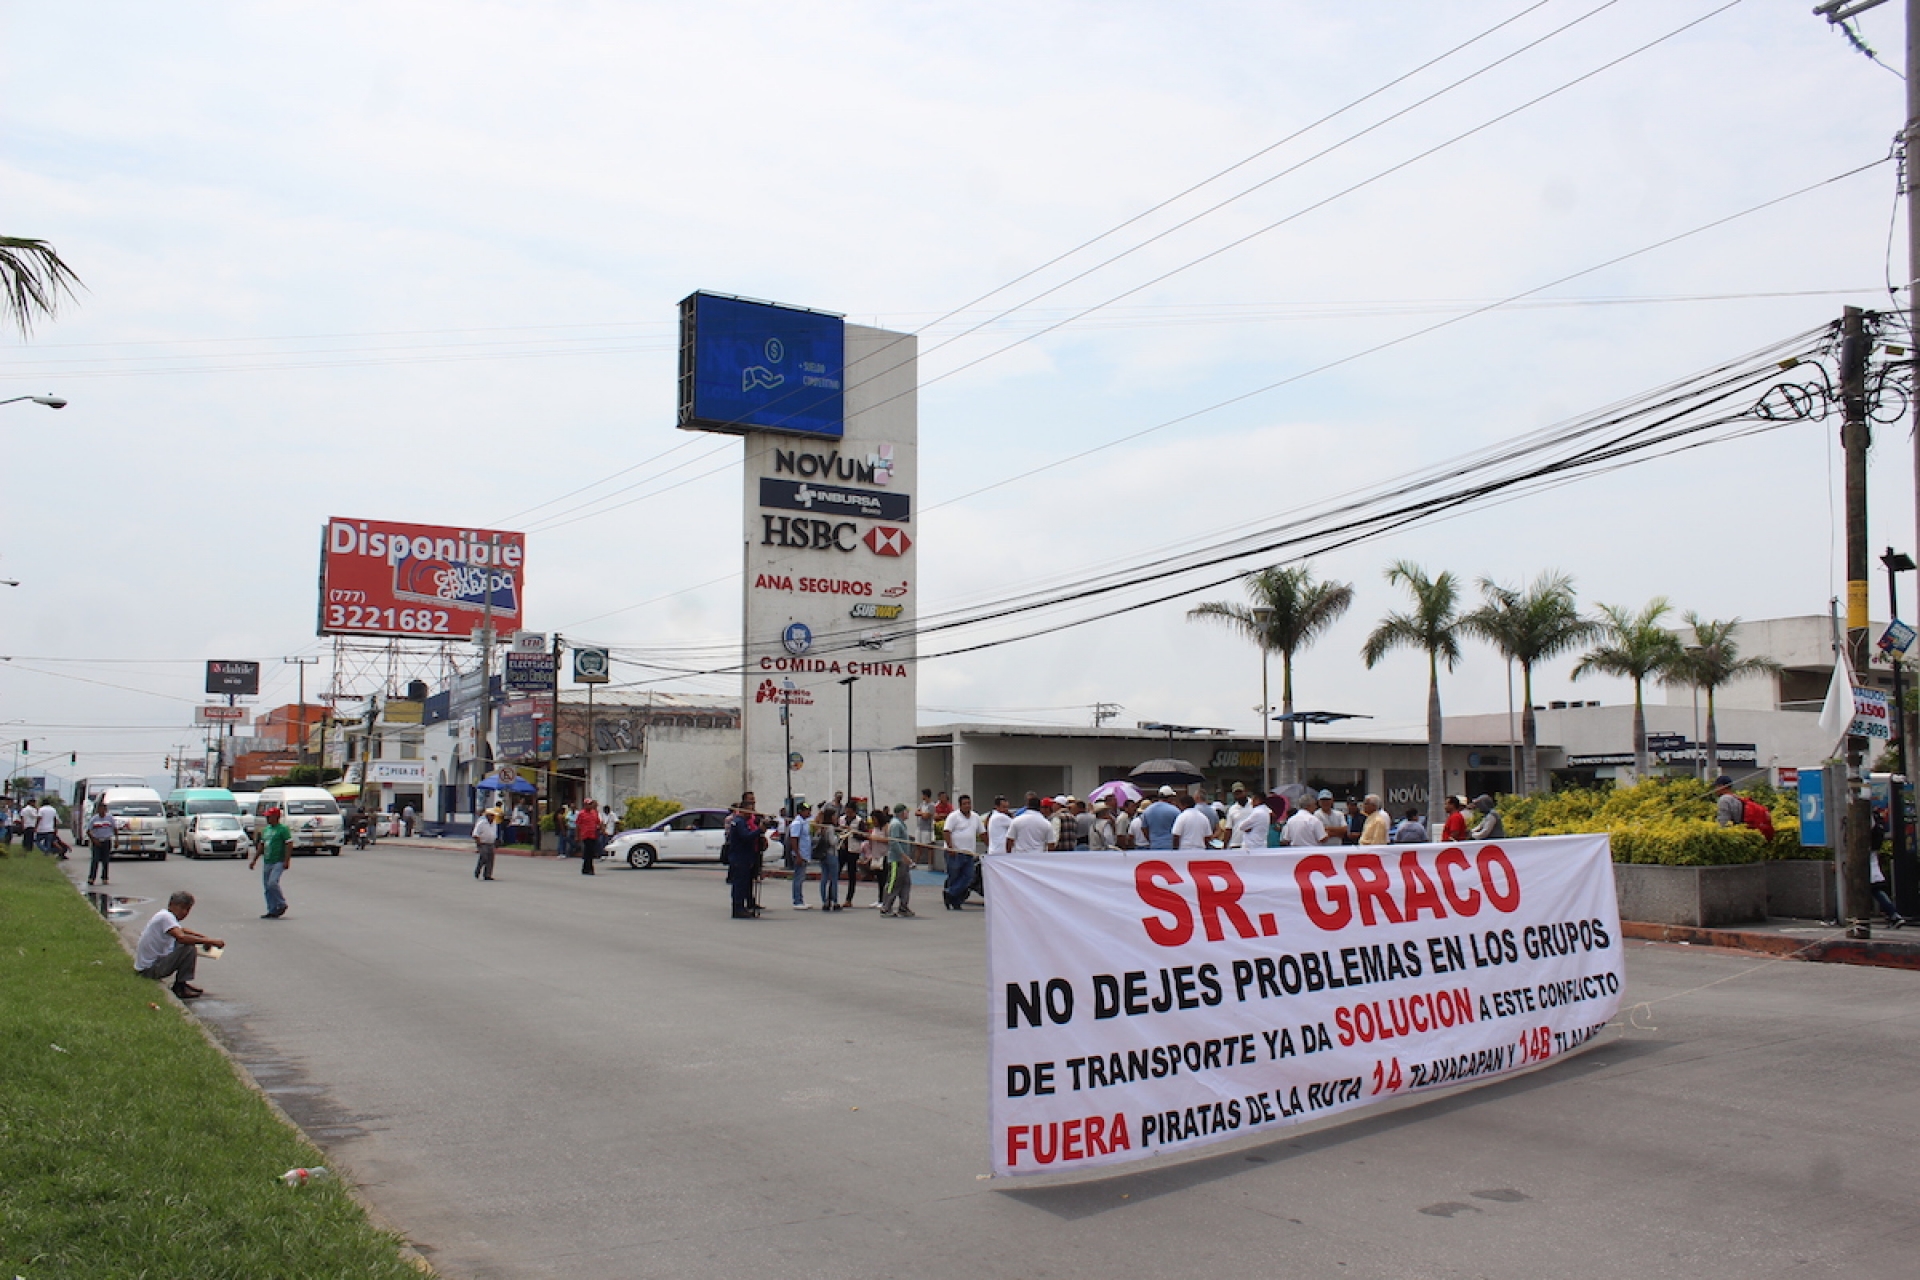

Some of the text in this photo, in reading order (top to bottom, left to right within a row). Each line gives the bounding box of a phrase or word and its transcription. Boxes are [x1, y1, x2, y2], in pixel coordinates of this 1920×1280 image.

[775, 448, 875, 483] NOVUM
[817, 490, 881, 507] INBURSA
[330, 521, 522, 566] Disponible
[761, 515, 857, 552] HSBC
[329, 588, 366, 603] (777)
[437, 574, 514, 599] GRABADO
[755, 574, 873, 596] ANA SEGUROS
[328, 604, 449, 632] 3221682
[853, 603, 902, 618] SUBWAY
[760, 656, 907, 677] COMIDA CHINA
[1135, 845, 1520, 946] SR. GRACO
[1006, 919, 1610, 1029] NO DEJES PROBLEMAS EN LOS GRUPOS
[1007, 972, 1619, 1098] DE TRANSPORTE YA DA SOLUCION A ESTE CONFLICTO
[1007, 1112, 1131, 1166] FUERA
[1141, 1099, 1242, 1147] PIRATAS
[1245, 1092, 1276, 1126] DE
[1276, 1086, 1303, 1118] LA
[1308, 1076, 1363, 1112] RUTA
[1372, 1057, 1403, 1095] 14
[1408, 1044, 1503, 1089] TLAYACAPAN
[1506, 1043, 1516, 1068] Y
[1519, 1025, 1551, 1064] 14B
